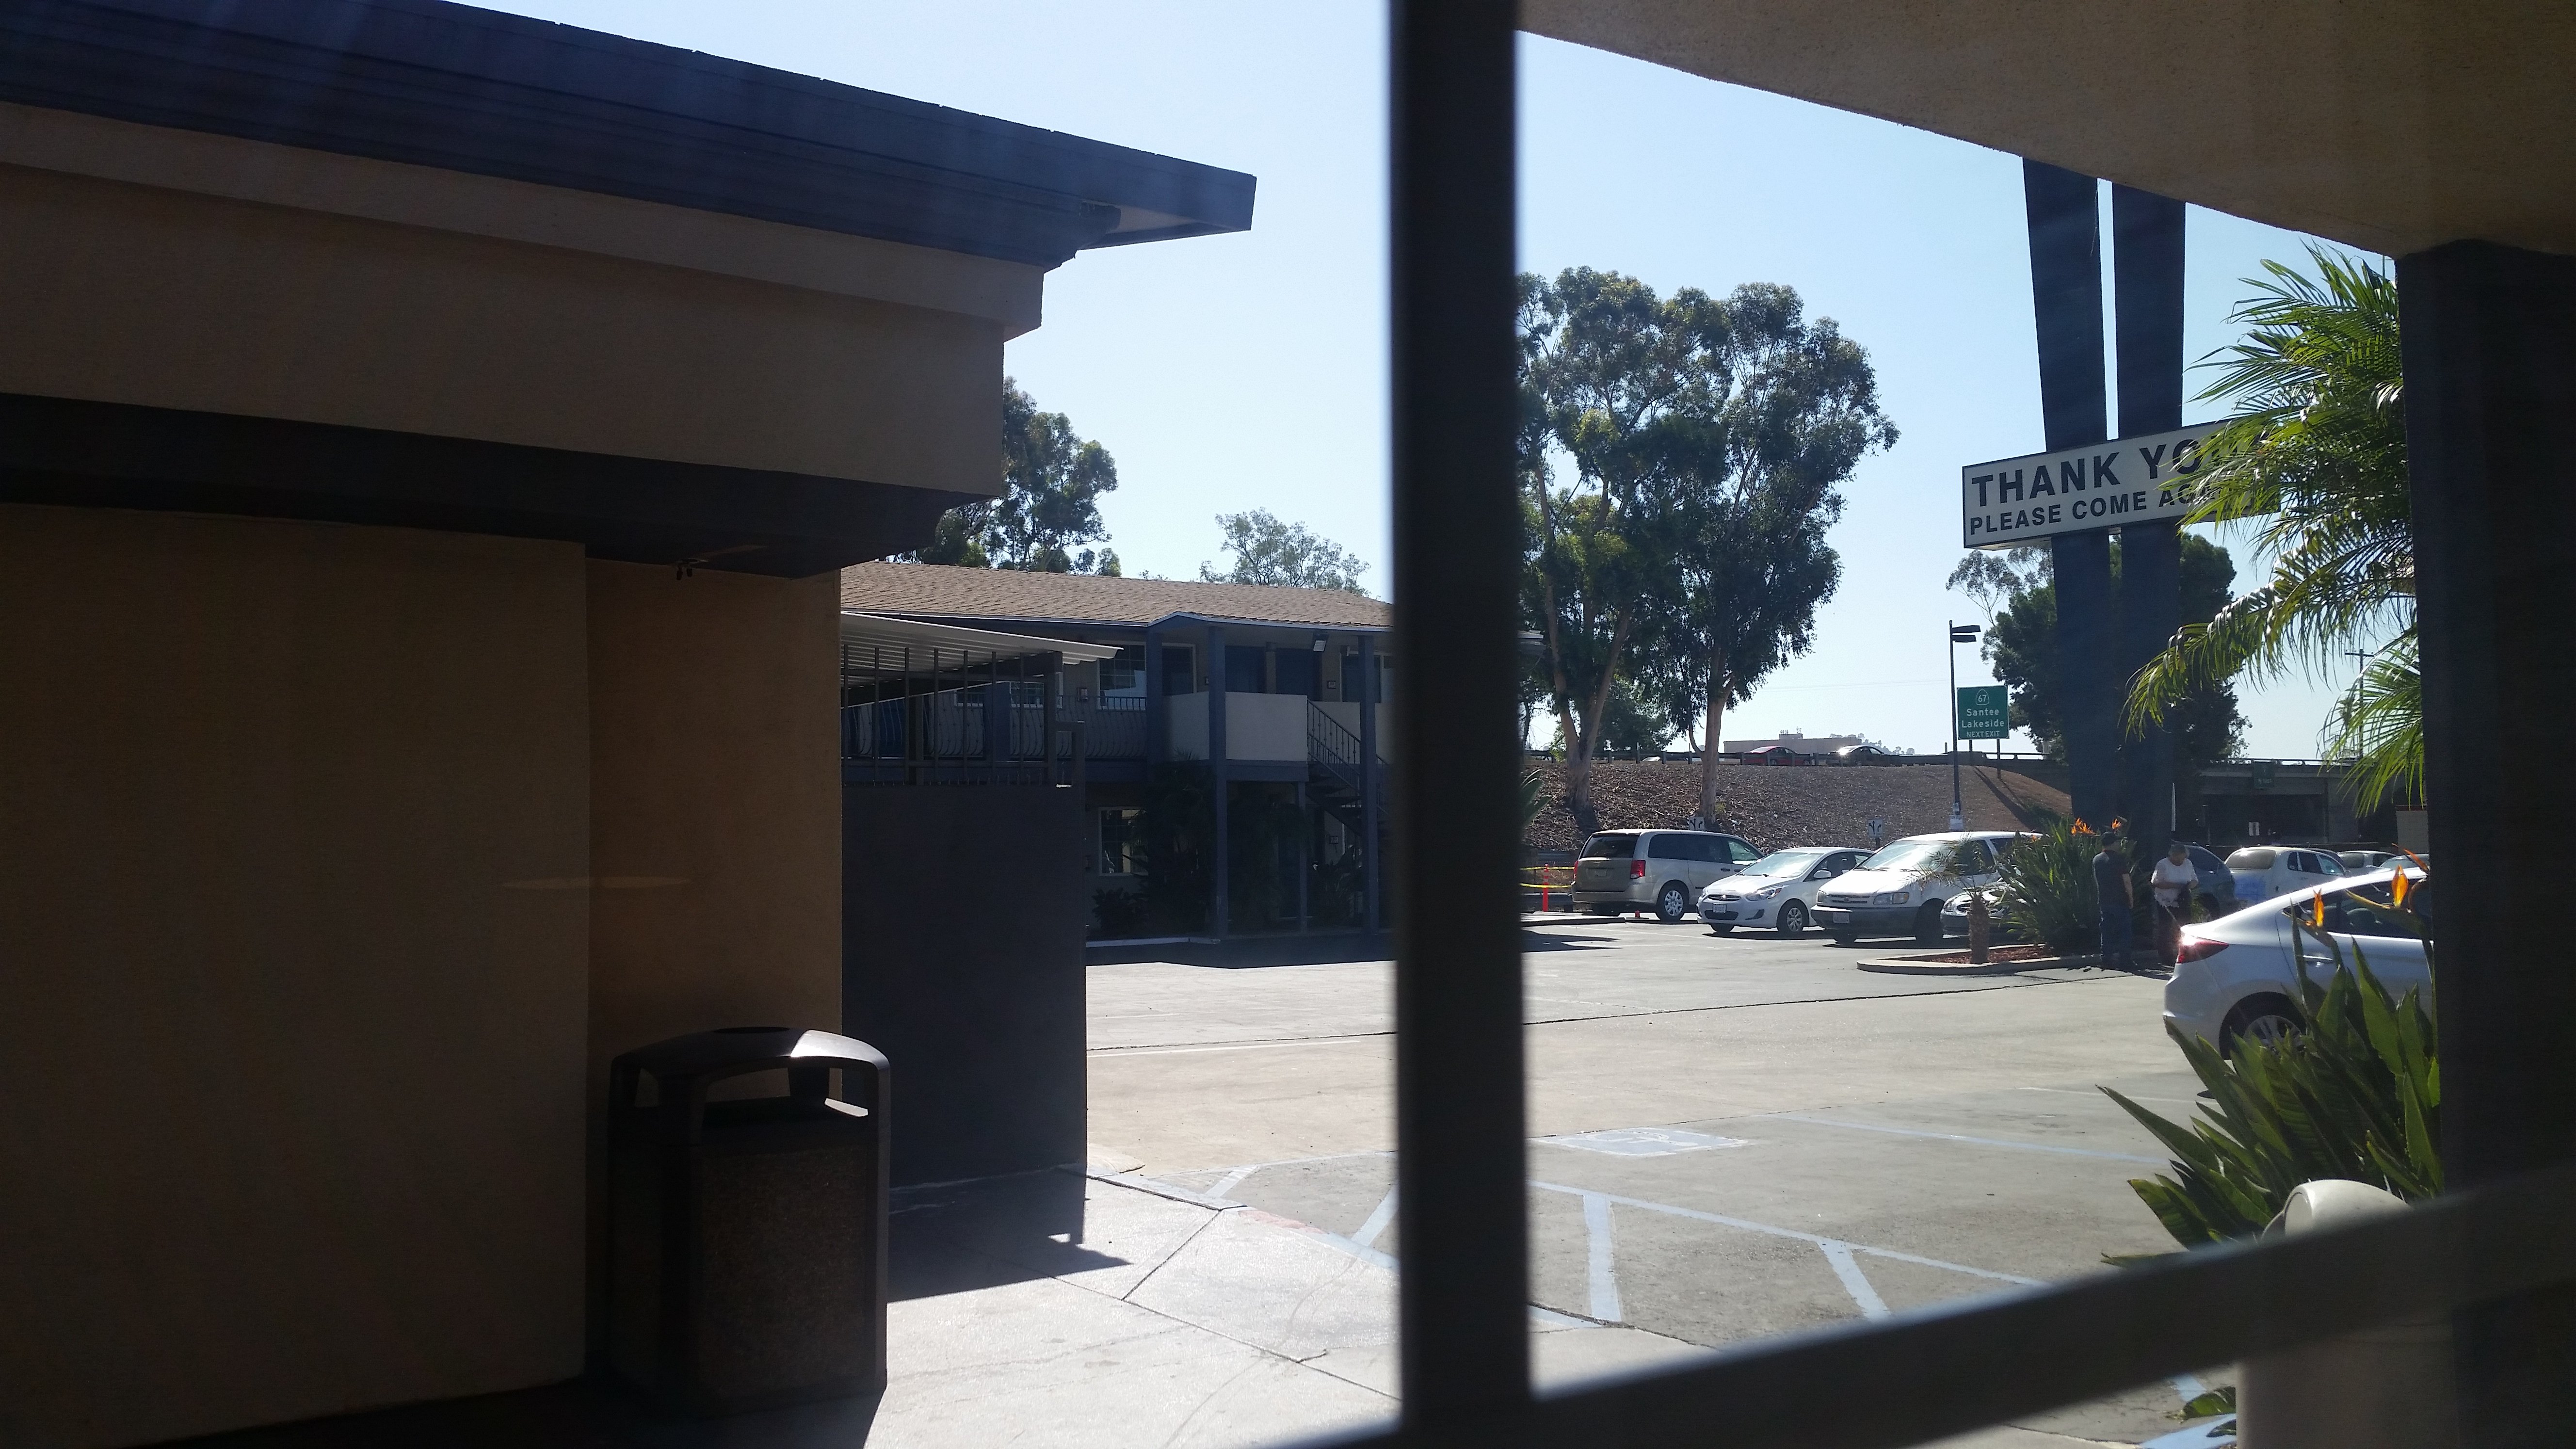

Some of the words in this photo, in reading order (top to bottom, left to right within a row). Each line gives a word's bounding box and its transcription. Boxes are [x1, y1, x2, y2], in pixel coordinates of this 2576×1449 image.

[1972, 451, 2121, 507] THANK
[2140, 433, 2238, 479] YO
[1970, 504, 2061, 535] PLEASE
[2072, 491, 2147, 520] COME
[1978, 694, 1987, 703] 67
[1966, 708, 1999, 716] Santee
[1962, 719, 2005, 728] Lakeside
